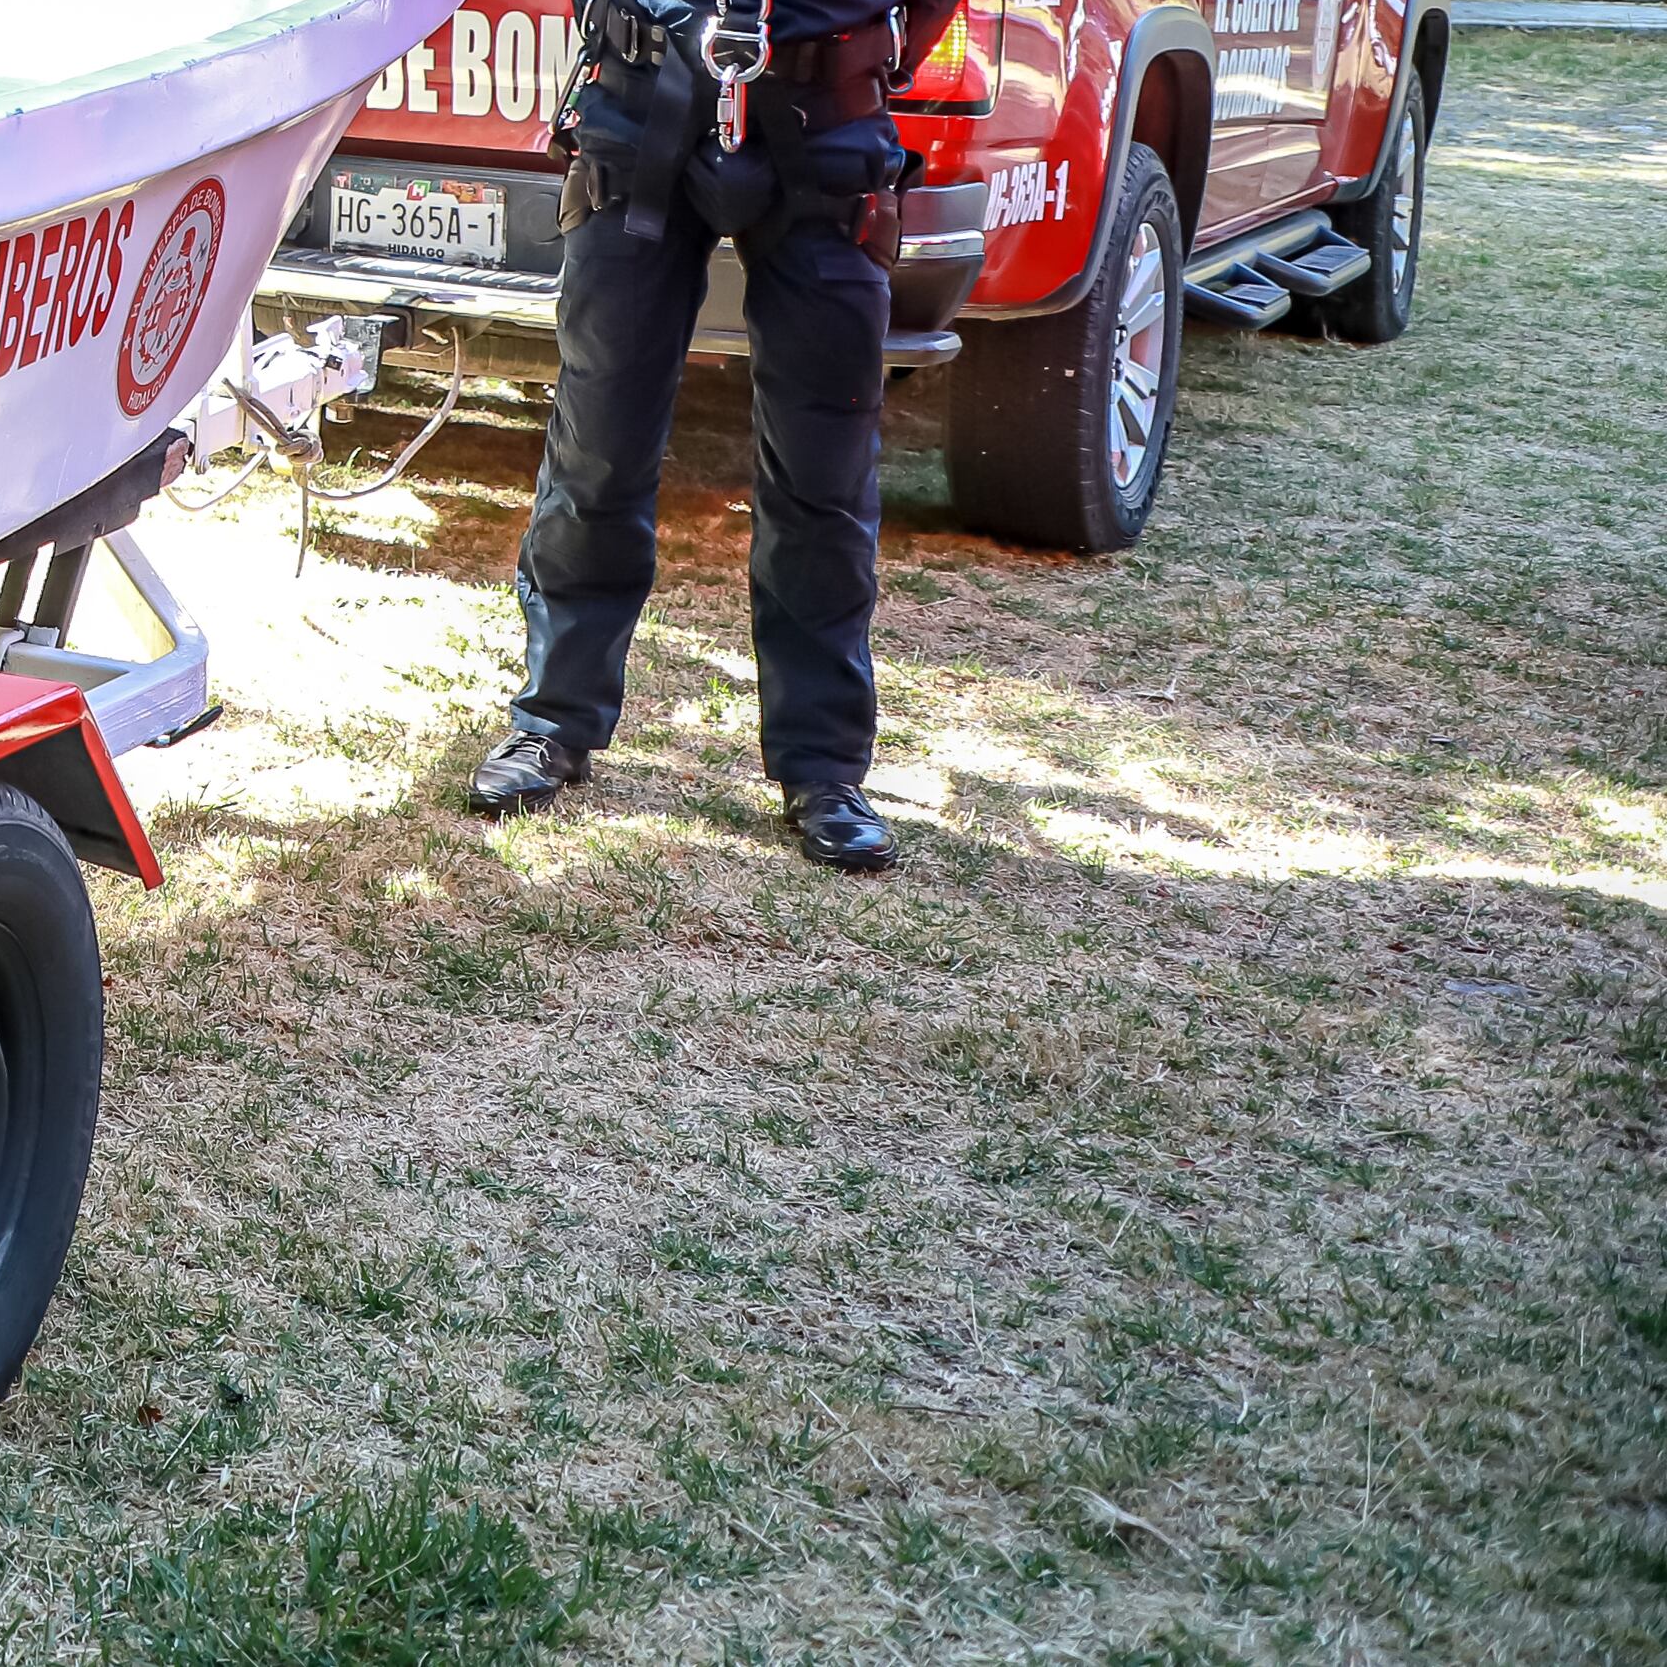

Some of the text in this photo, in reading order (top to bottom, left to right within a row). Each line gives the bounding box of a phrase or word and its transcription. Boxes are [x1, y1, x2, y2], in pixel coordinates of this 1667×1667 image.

[336, 195, 496, 247] HG-365A-1
[982, 160, 1069, 231] HG-365A-1
[142, 206, 188, 288] CUERPO
[190, 190, 204, 211] DE
[387, 243, 445, 258] HIDALGO
[125, 374, 167, 411] HIDALGO
